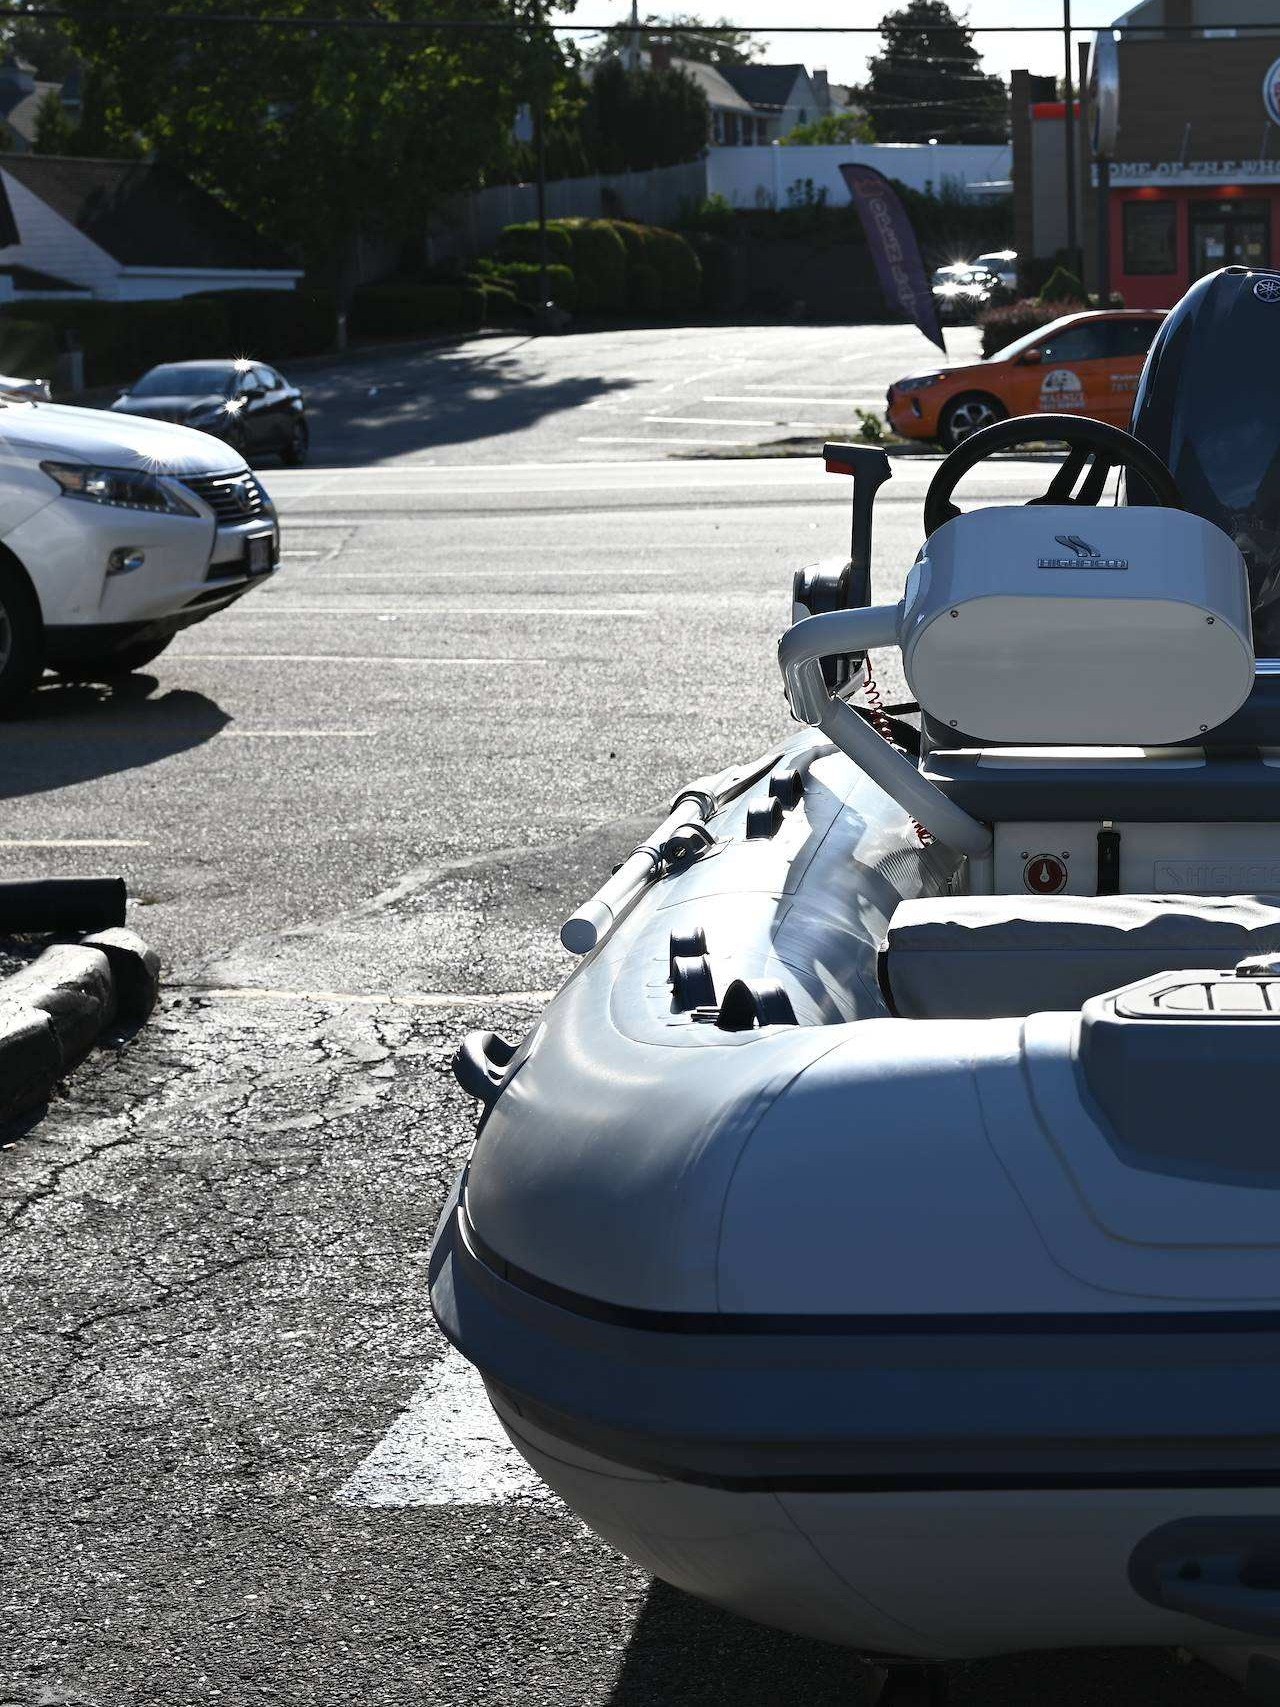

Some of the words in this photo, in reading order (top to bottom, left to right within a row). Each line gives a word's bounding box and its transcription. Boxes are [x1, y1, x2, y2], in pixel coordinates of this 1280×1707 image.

[1155, 161, 1185, 176] OF
[1189, 160, 1236, 176] THE
[1037, 558, 1129, 569] HIGHFIELD
